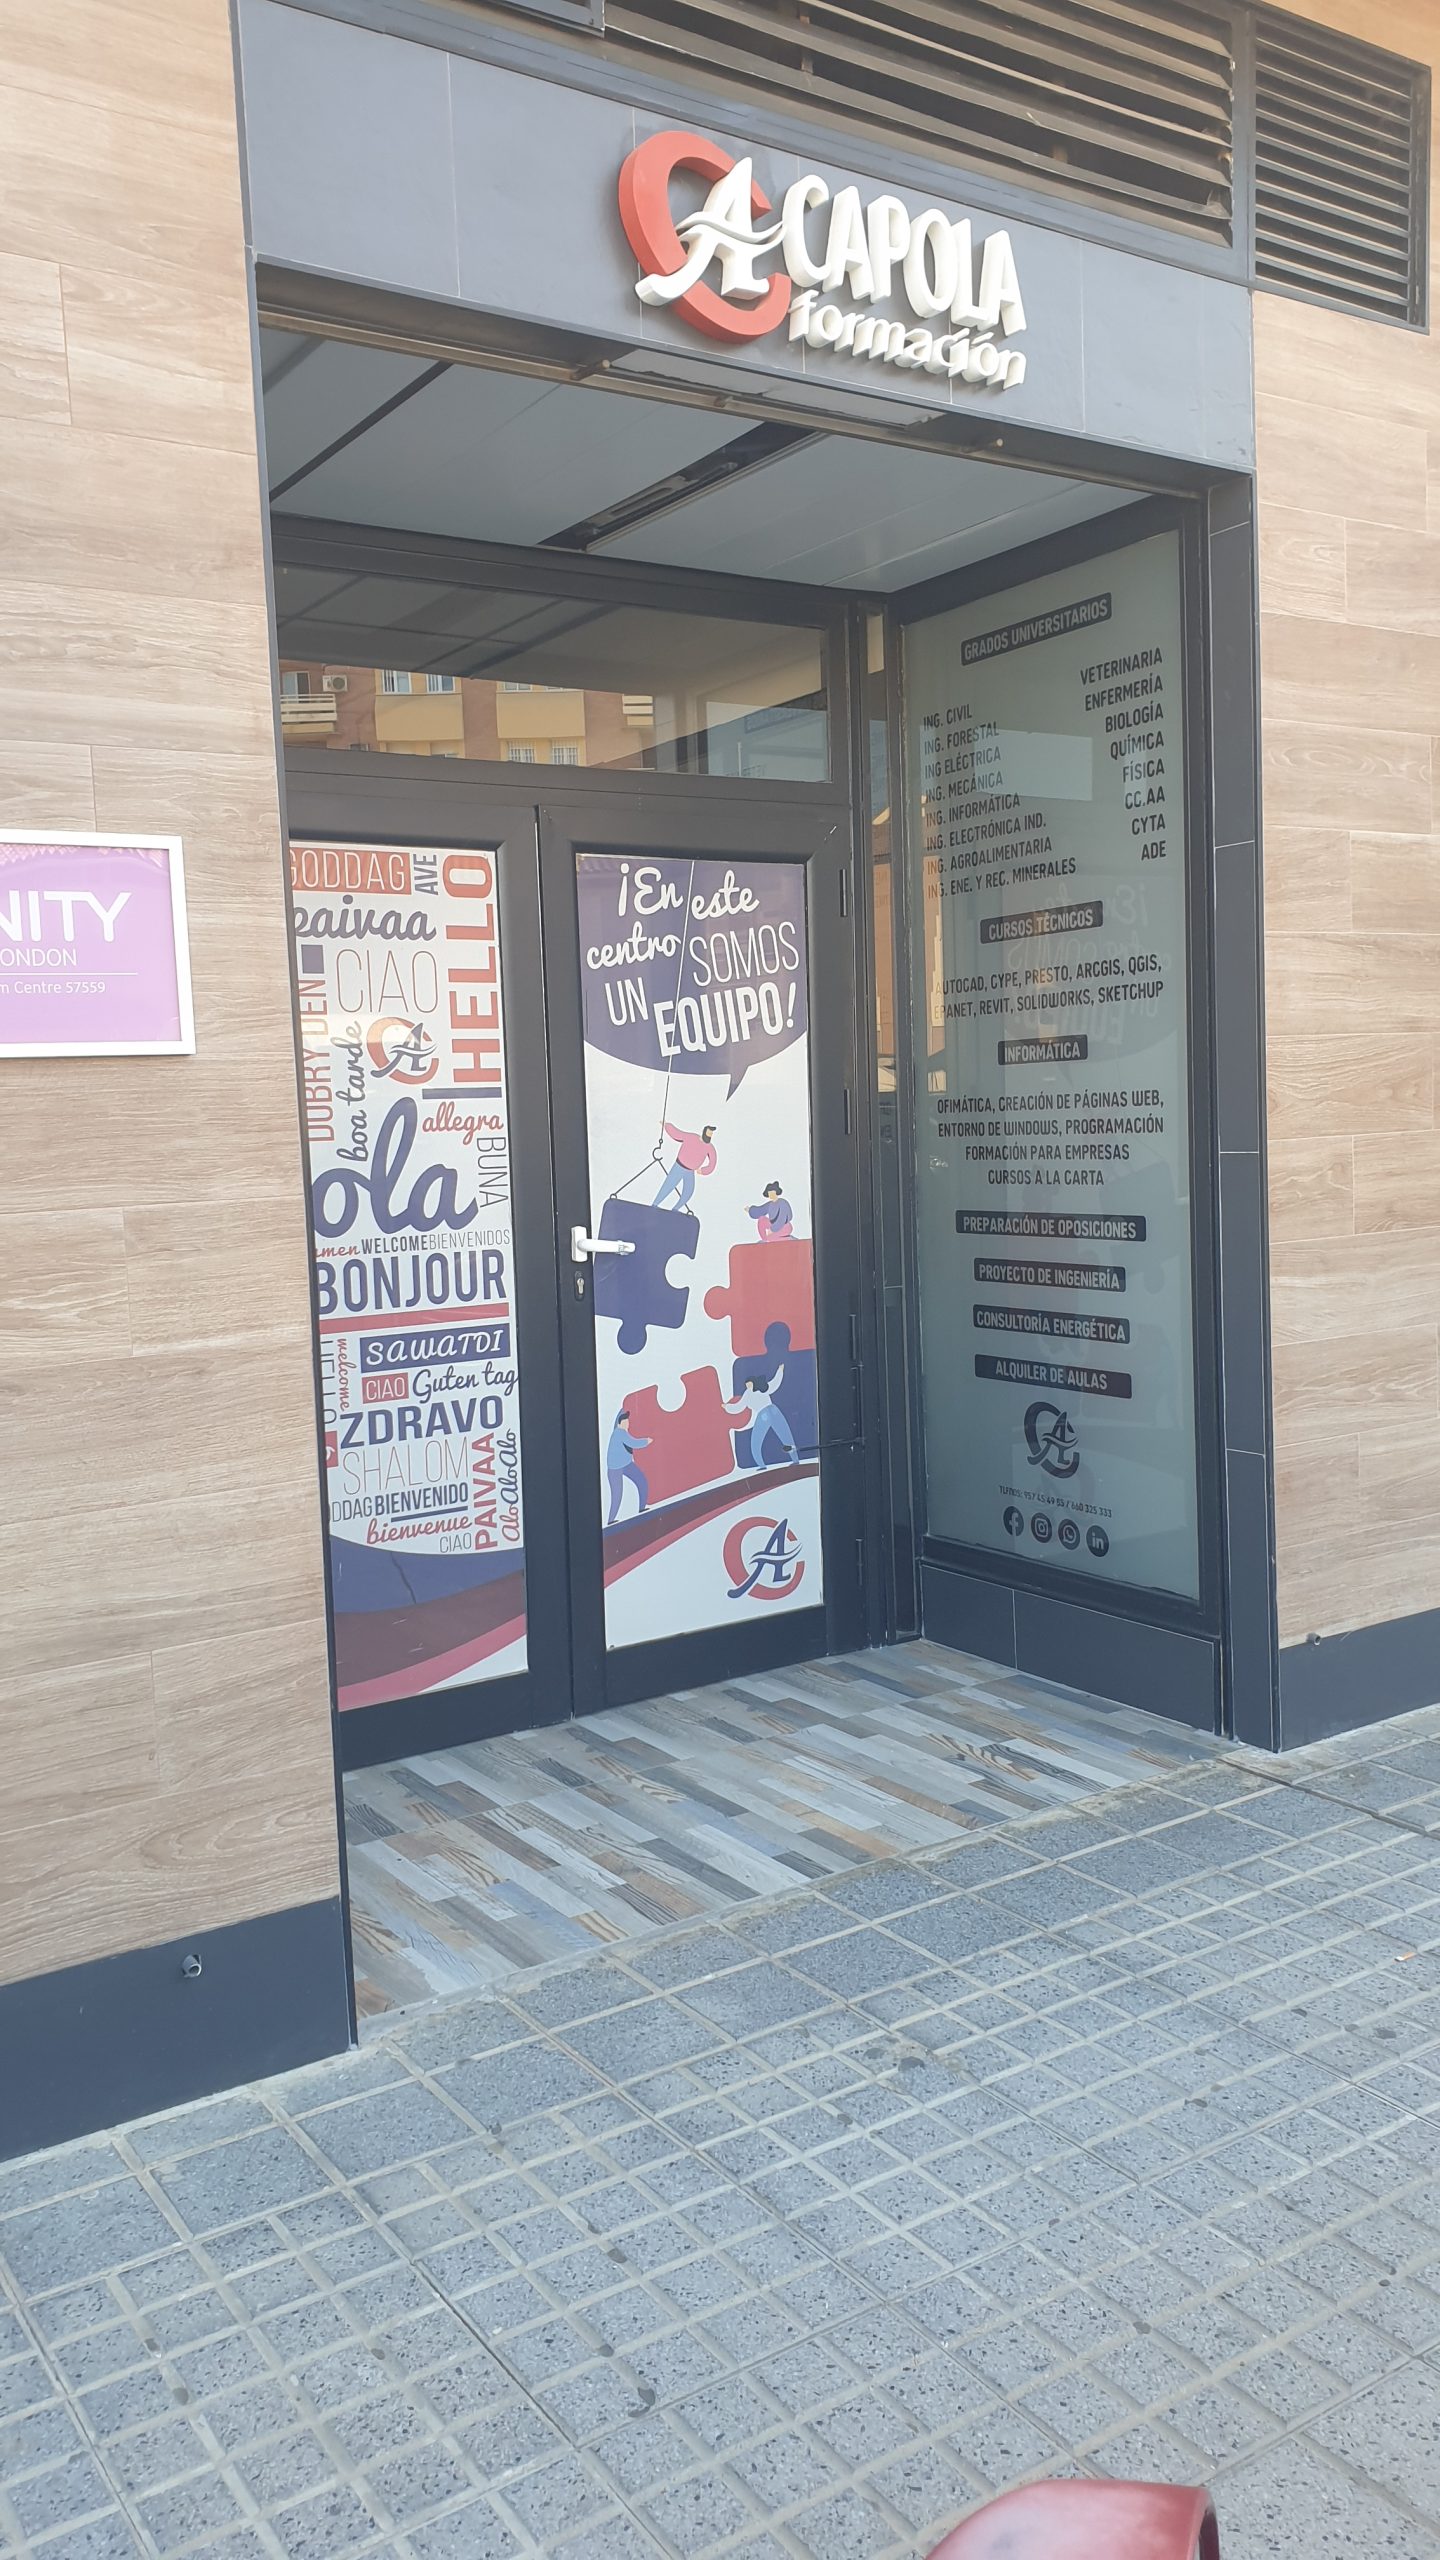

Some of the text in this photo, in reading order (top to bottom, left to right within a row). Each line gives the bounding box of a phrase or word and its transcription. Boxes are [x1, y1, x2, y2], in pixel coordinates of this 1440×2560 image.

[788, 288, 1027, 390] formación
[964, 598, 1108, 661] GRADOS UNIVERSITARIOS
[1080, 647, 1162, 685] VETERINARIA
[1085, 675, 1163, 711] ENFERMERÍA
[923, 703, 972, 731] ING. CIVIL
[1105, 702, 1164, 733] BIOLOGÍA
[924, 721, 999, 755] ING. FORESTAL
[1110, 730, 1164, 760] QUÍMICA
[944, 746, 1001, 774] ELÉCTRICA
[1122, 758, 1165, 783] FÍSICA
[925, 771, 1003, 803] ING. MECÁNICA
[926, 793, 1021, 827] ING. INFORMÁTICA
[1131, 813, 1166, 836] CYTA
[927, 812, 1046, 851] ING. ELECTRÓNICA IND.
[927, 836, 1052, 875] ING. AGROALIMENTARIA
[1141, 840, 1167, 861] ADE
[413, 853, 439, 896] AVE
[928, 857, 1076, 899] ING. ENE. Y REC. MINERALES
[691, 870, 760, 920] este
[989, 908, 1094, 941] CURSOS TÉCNICOS
[443, 854, 502, 1083] HELLO
[586, 921, 799, 987] centro SOMOS
[14, 981, 62, 994] Centre
[66, 981, 106, 994] 57559
[336, 949, 438, 1014] CIAO
[936, 953, 1162, 996] AUTOCAD, CYPE, PRESTO, ARCGIS, QGIS,
[934, 981, 1164, 1019] EPANET, REVIT, SOLIDWORKS, SKETCHUP
[604, 977, 797, 1058] UN EQUIPO!
[1004, 1040, 1080, 1062] INFORMÁTICA
[330, 1021, 368, 1162] boa tarde
[937, 1089, 1164, 1114] OFIMÁTICA, CREACIÓN DE PÁGINAS WEB,
[422, 1101, 504, 1145] allegra
[938, 1114, 1164, 1137] ENTORNO DE WINDOWS, PROGRAMACIÓN
[965, 1142, 1130, 1161] FORMACIÓN PARA EMPRESAS
[477, 1137, 509, 1208] BUNA
[988, 1169, 1104, 1186] CURSOS A LA CARTA
[361, 1235, 428, 1255] WELCOME
[429, 1229, 510, 1249] BIENVENIDOS
[963, 1214, 1136, 1239] PREPARACIÓN DE OPOSICIONES
[317, 1249, 507, 1314] BONJOUR
[979, 1264, 1120, 1290] PROYECTO DE INGENIERÍA
[976, 1310, 1126, 1341] CONSULTORÍA ENERGÉTICA
[336, 1338, 357, 1411] welcome
[366, 1377, 405, 1400] CIAO
[412, 1361, 519, 1404] Guten tag
[995, 1360, 1108, 1390] ALQUILER DE AULAS
[340, 1395, 504, 1449] ZDRAVO
[343, 1436, 469, 1495] SHALOM
[374, 1482, 469, 1516] BIENVENIDO
[471, 1432, 498, 1550] PAIVAA
[366, 1515, 473, 1545] bienvenue
[439, 1532, 472, 1554] CIAO
